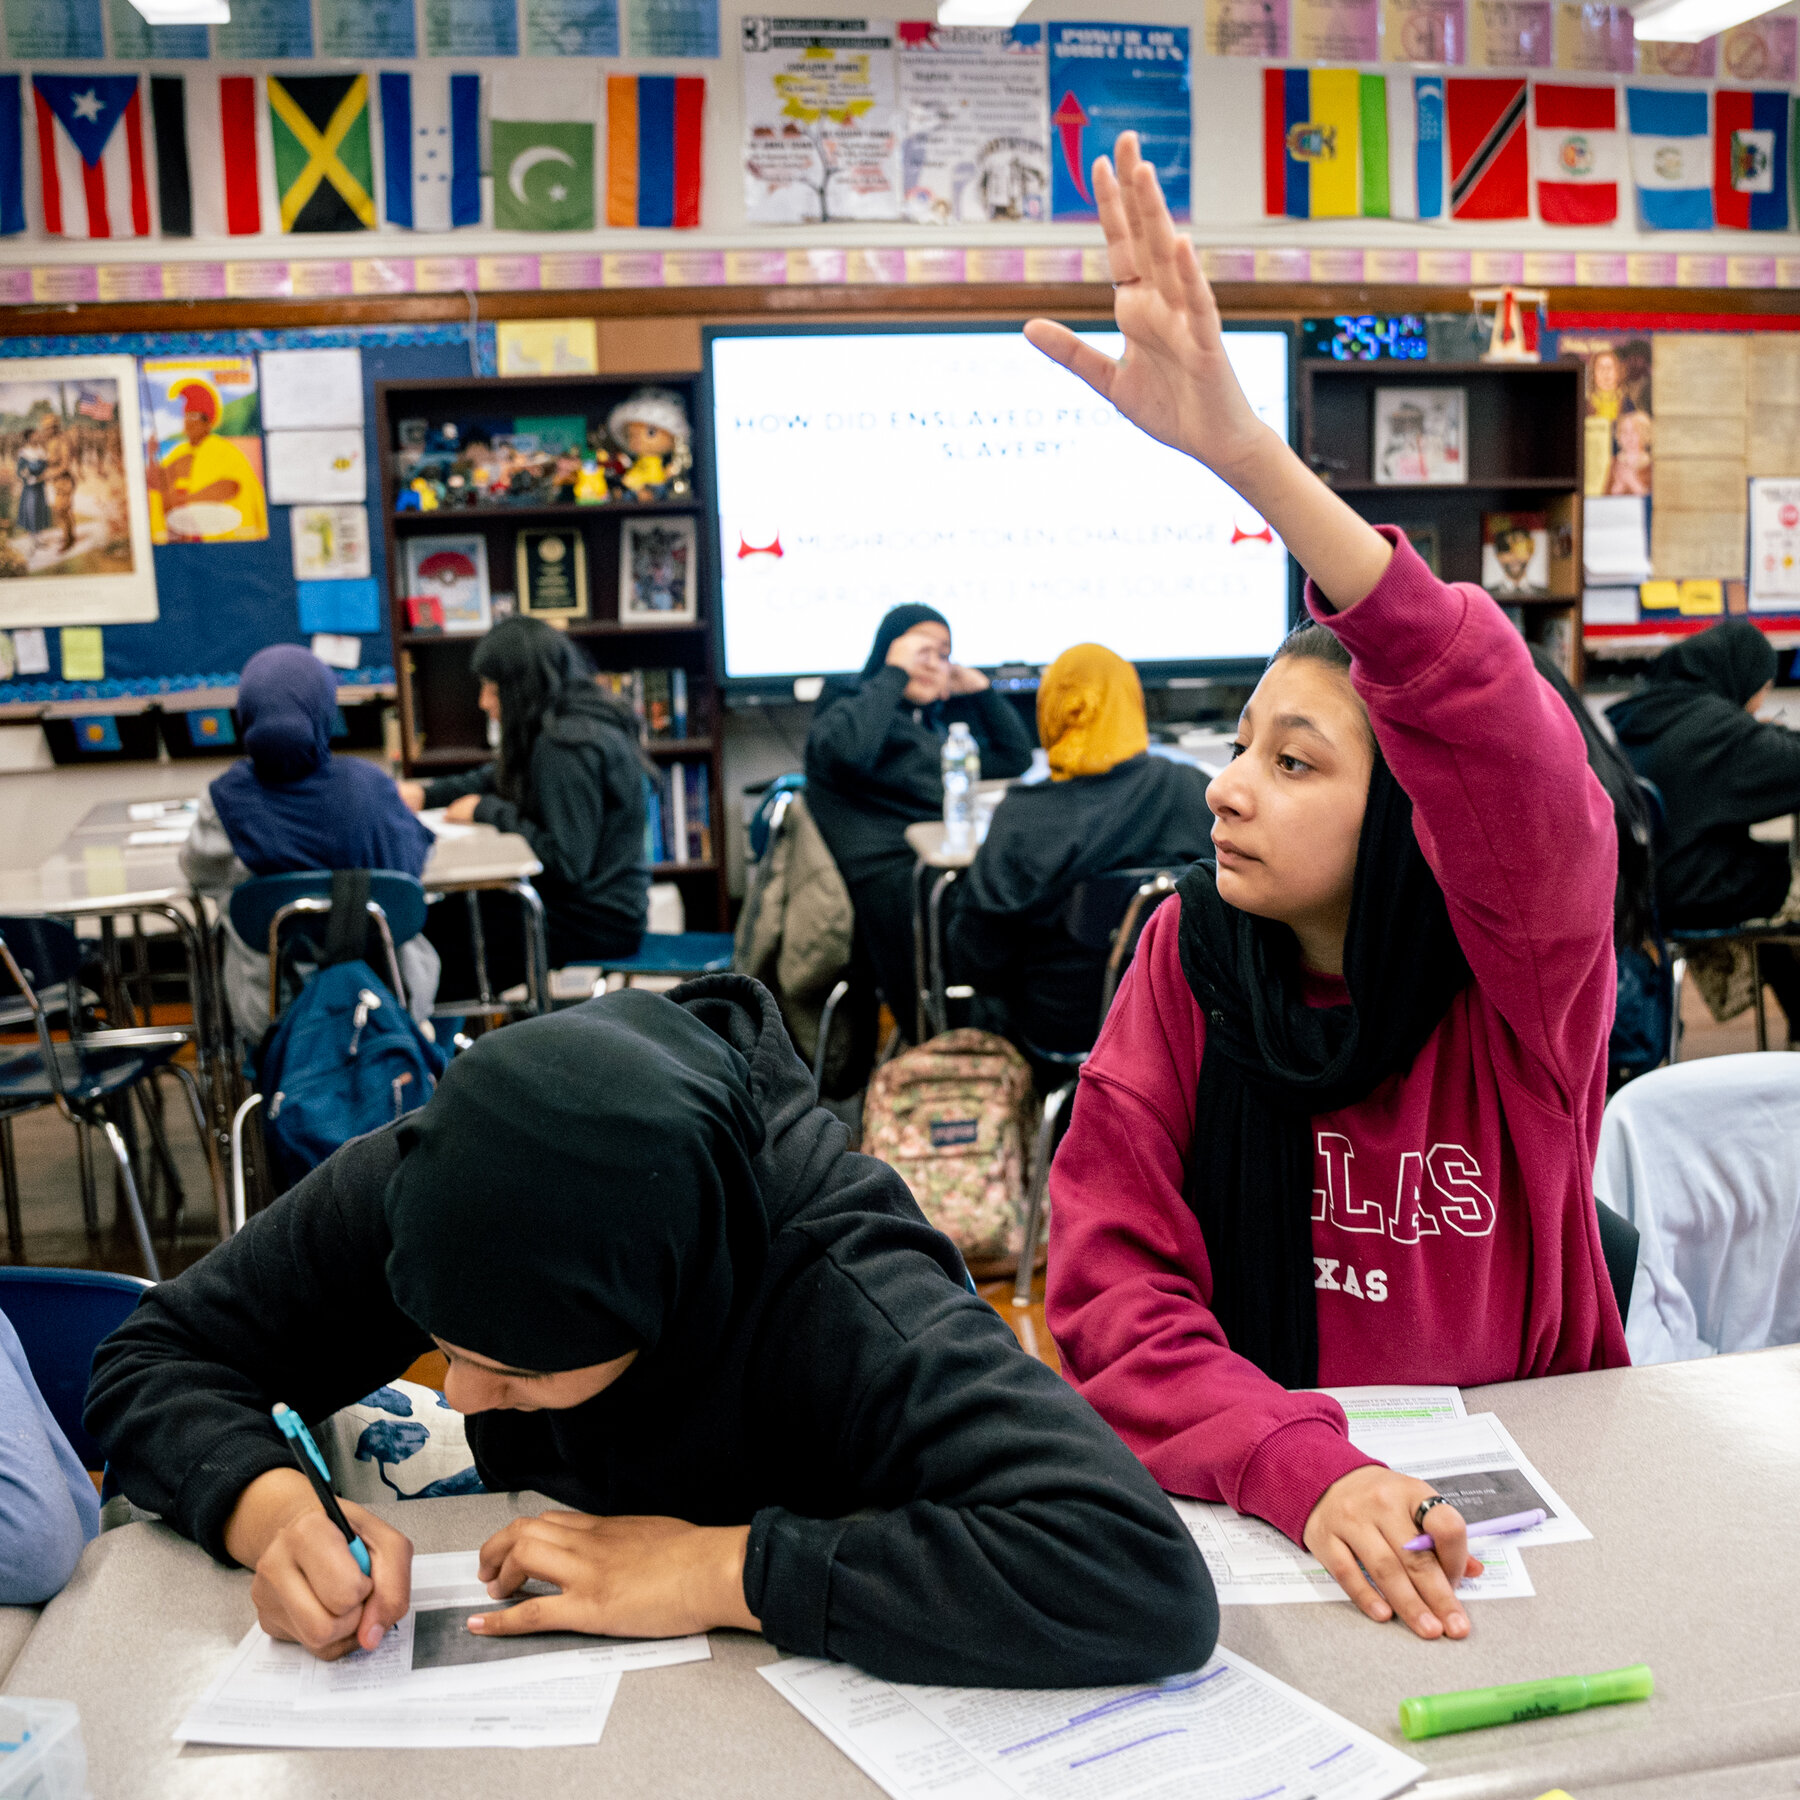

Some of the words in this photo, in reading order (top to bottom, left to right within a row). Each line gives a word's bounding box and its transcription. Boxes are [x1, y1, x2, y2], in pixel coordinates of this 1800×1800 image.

[734, 412, 811, 433] HOW
[825, 410, 878, 431] DID
[890, 407, 1043, 431] ENSLAVED
[1065, 522, 1219, 548] CHALLENGE
[1313, 1257, 1388, 1302] XAS
